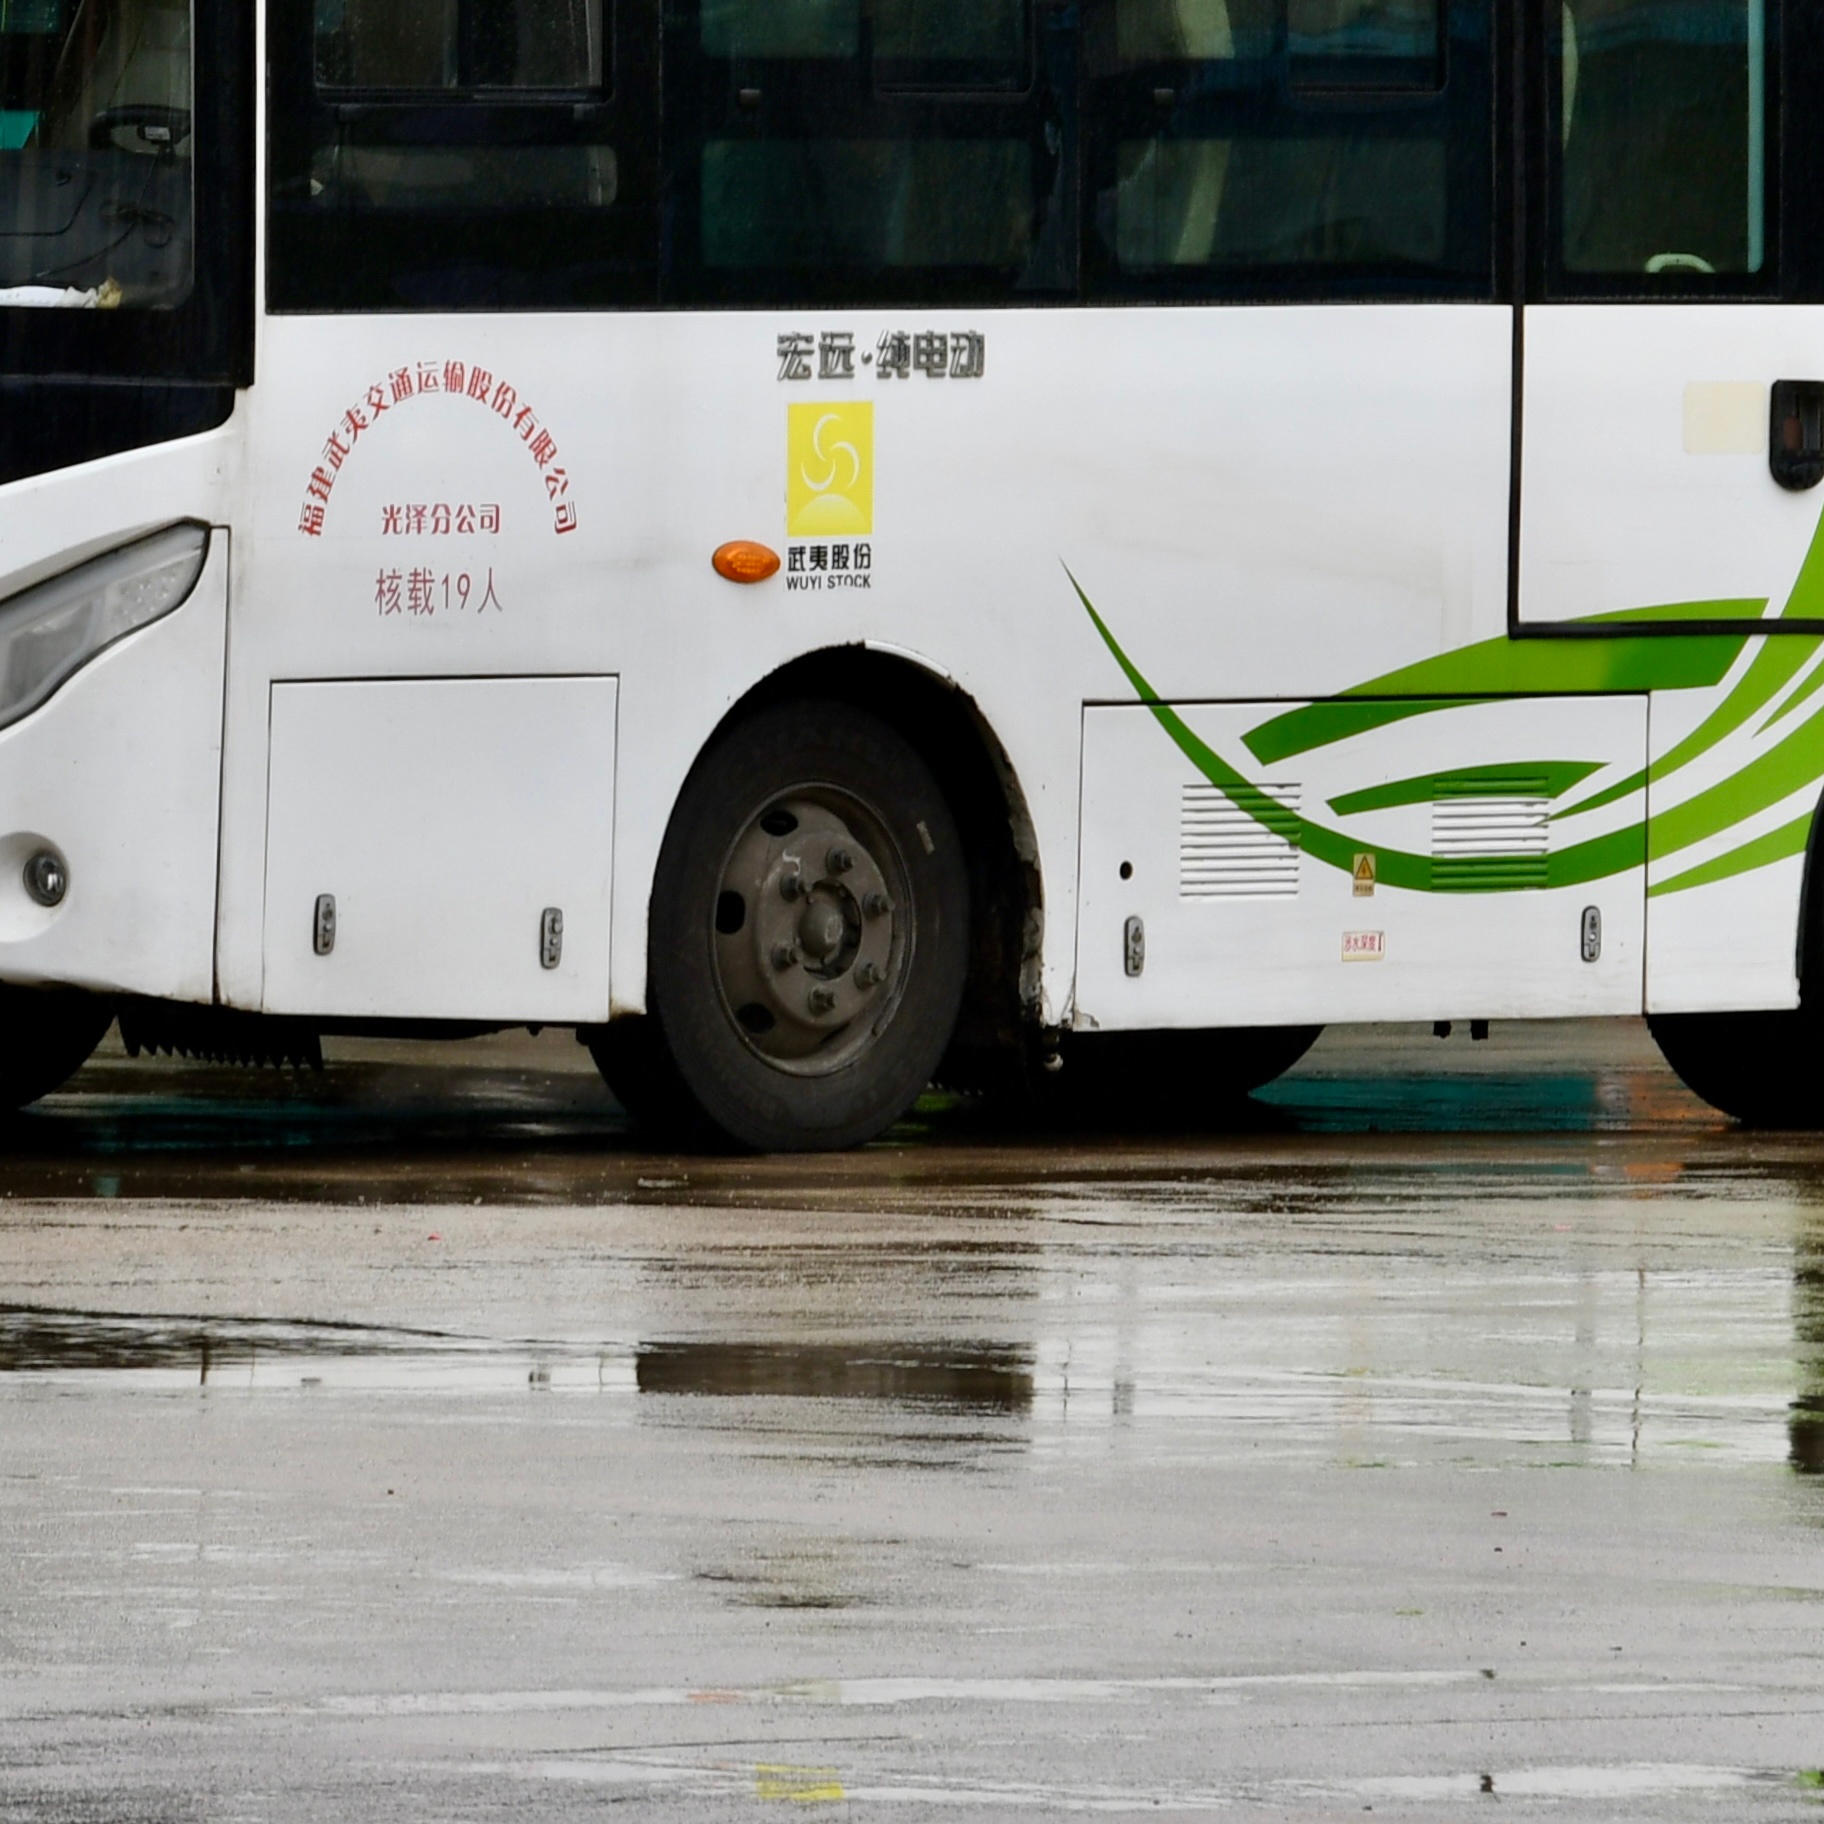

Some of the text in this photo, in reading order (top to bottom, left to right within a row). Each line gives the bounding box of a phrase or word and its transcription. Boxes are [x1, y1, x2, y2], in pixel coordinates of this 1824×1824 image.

[297, 359, 578, 537] 福建武夷交通运输股份有限公司
[381, 503, 501, 535] 光泽分公司
[787, 543, 872, 573] 武夷股份
[374, 566, 503, 616] 核载19人
[785, 575, 823, 592] WUYI
